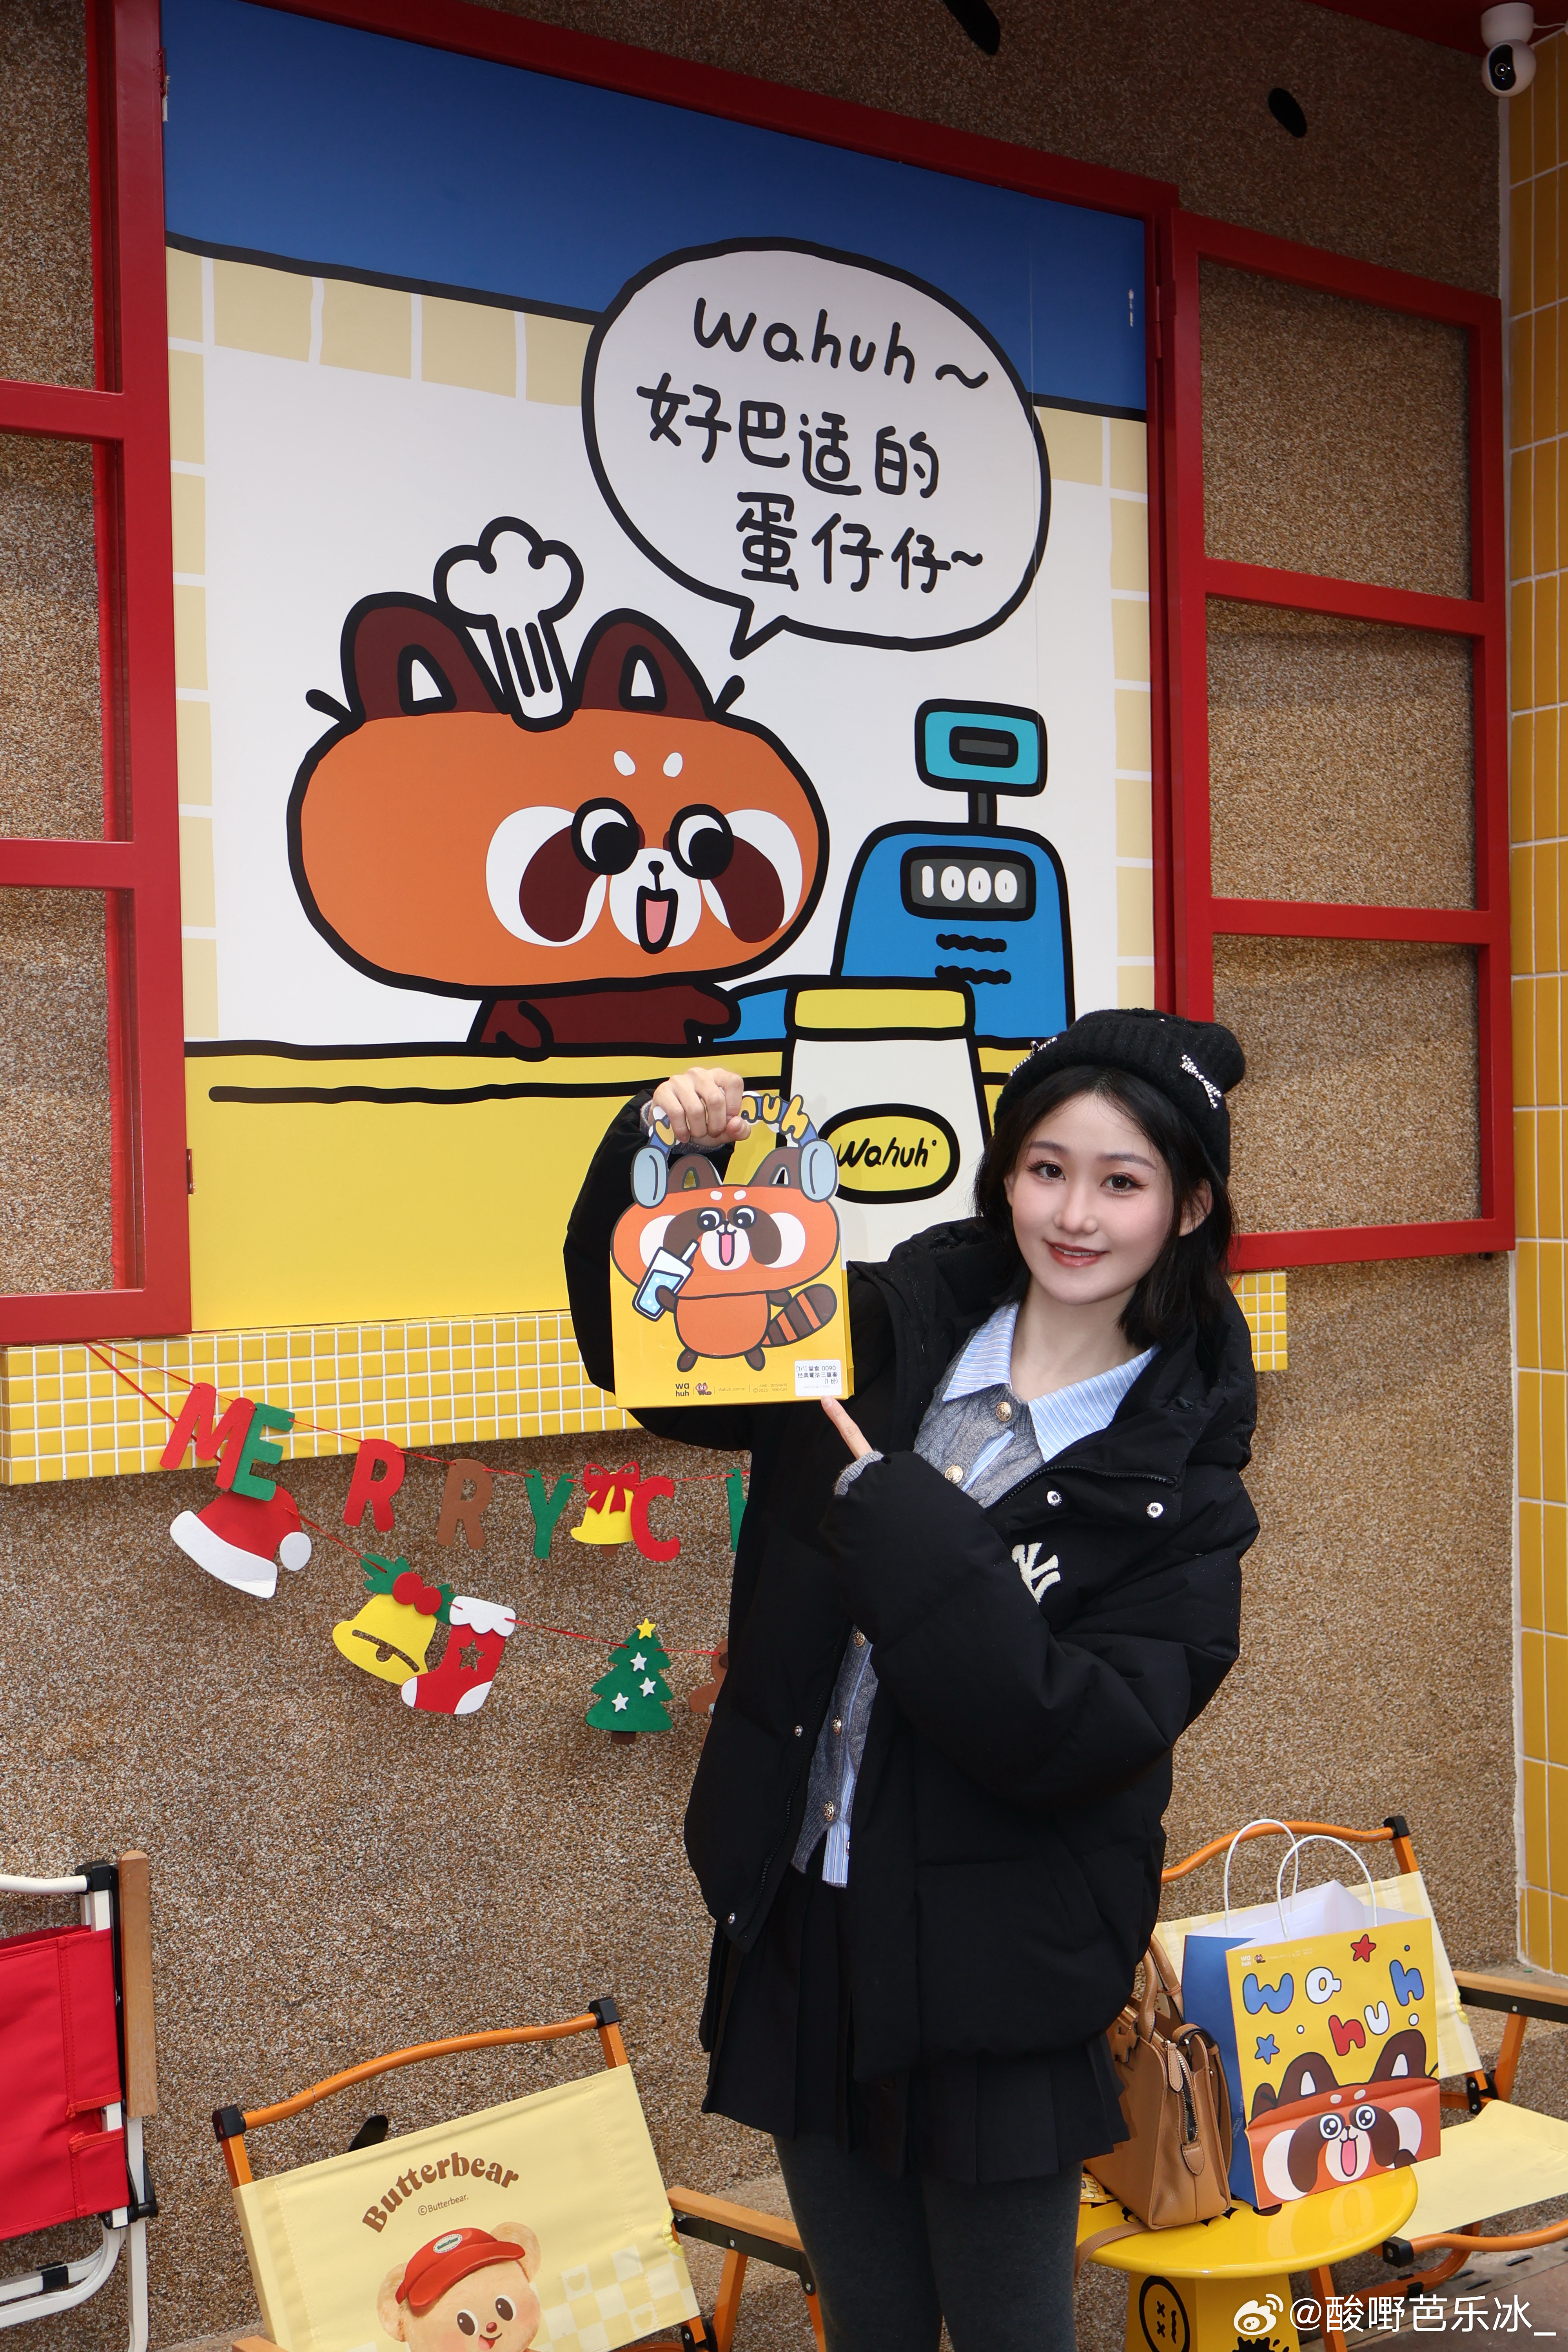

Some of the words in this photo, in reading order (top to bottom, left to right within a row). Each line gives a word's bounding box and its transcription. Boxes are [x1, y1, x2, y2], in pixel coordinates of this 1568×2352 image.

[636, 372, 939, 498] 好巴适的
[362, 2152, 519, 2233] Butterbear
